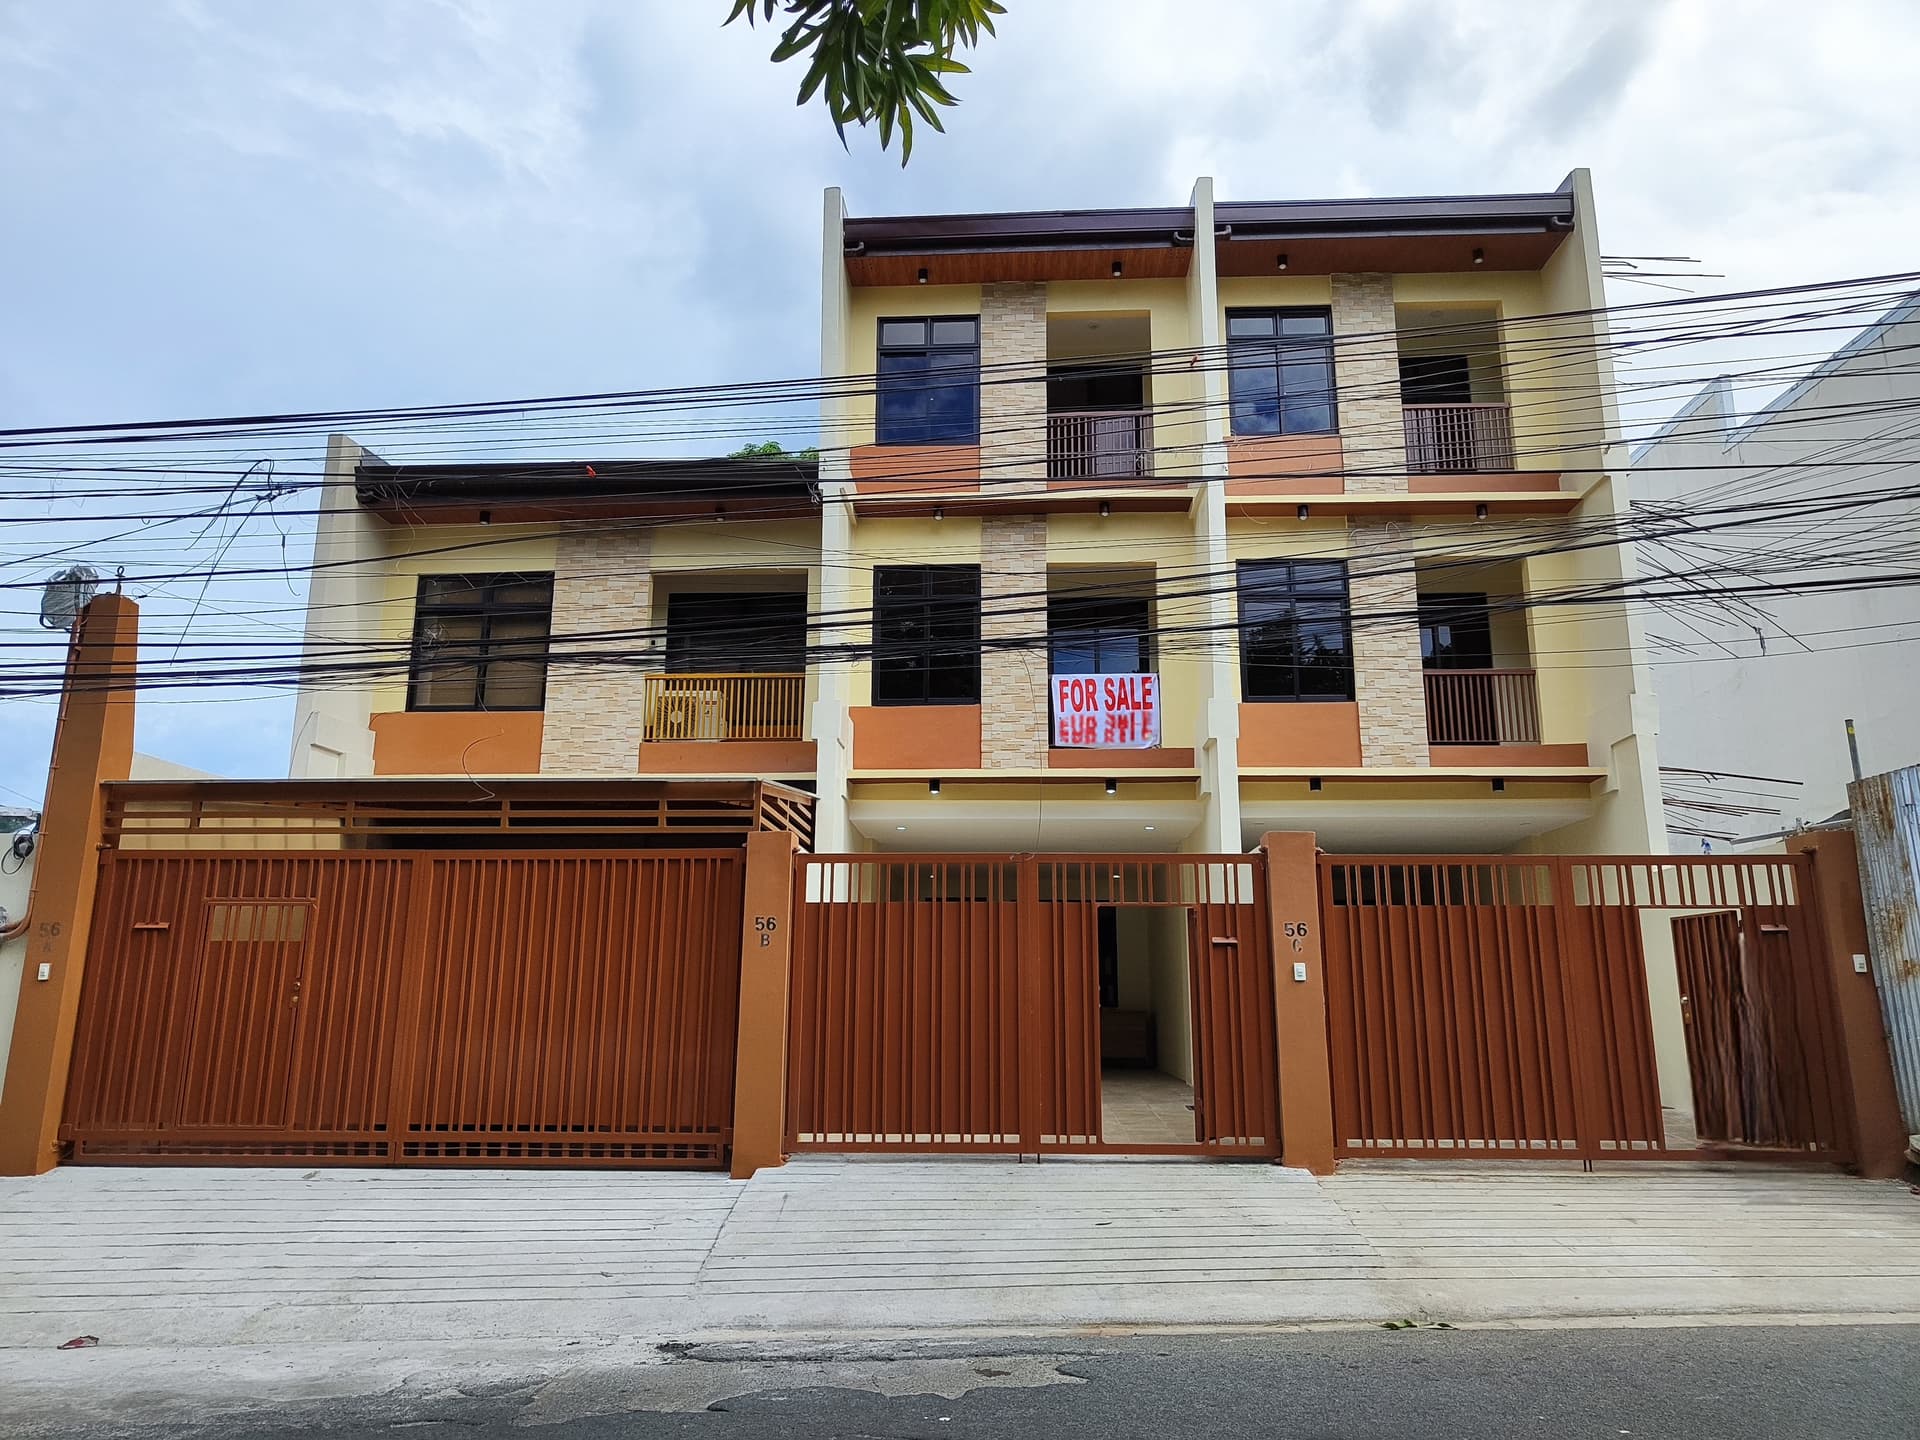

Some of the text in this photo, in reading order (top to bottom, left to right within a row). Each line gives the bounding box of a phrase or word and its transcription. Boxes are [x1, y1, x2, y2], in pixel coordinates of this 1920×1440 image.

[1059, 677, 1153, 712] FOR SALE
[40, 922, 60, 937] 56
[755, 916, 776, 931] 56
[1284, 922, 1307, 937] 56
[760, 934, 770, 947] B
[1292, 939, 1302, 952] C
